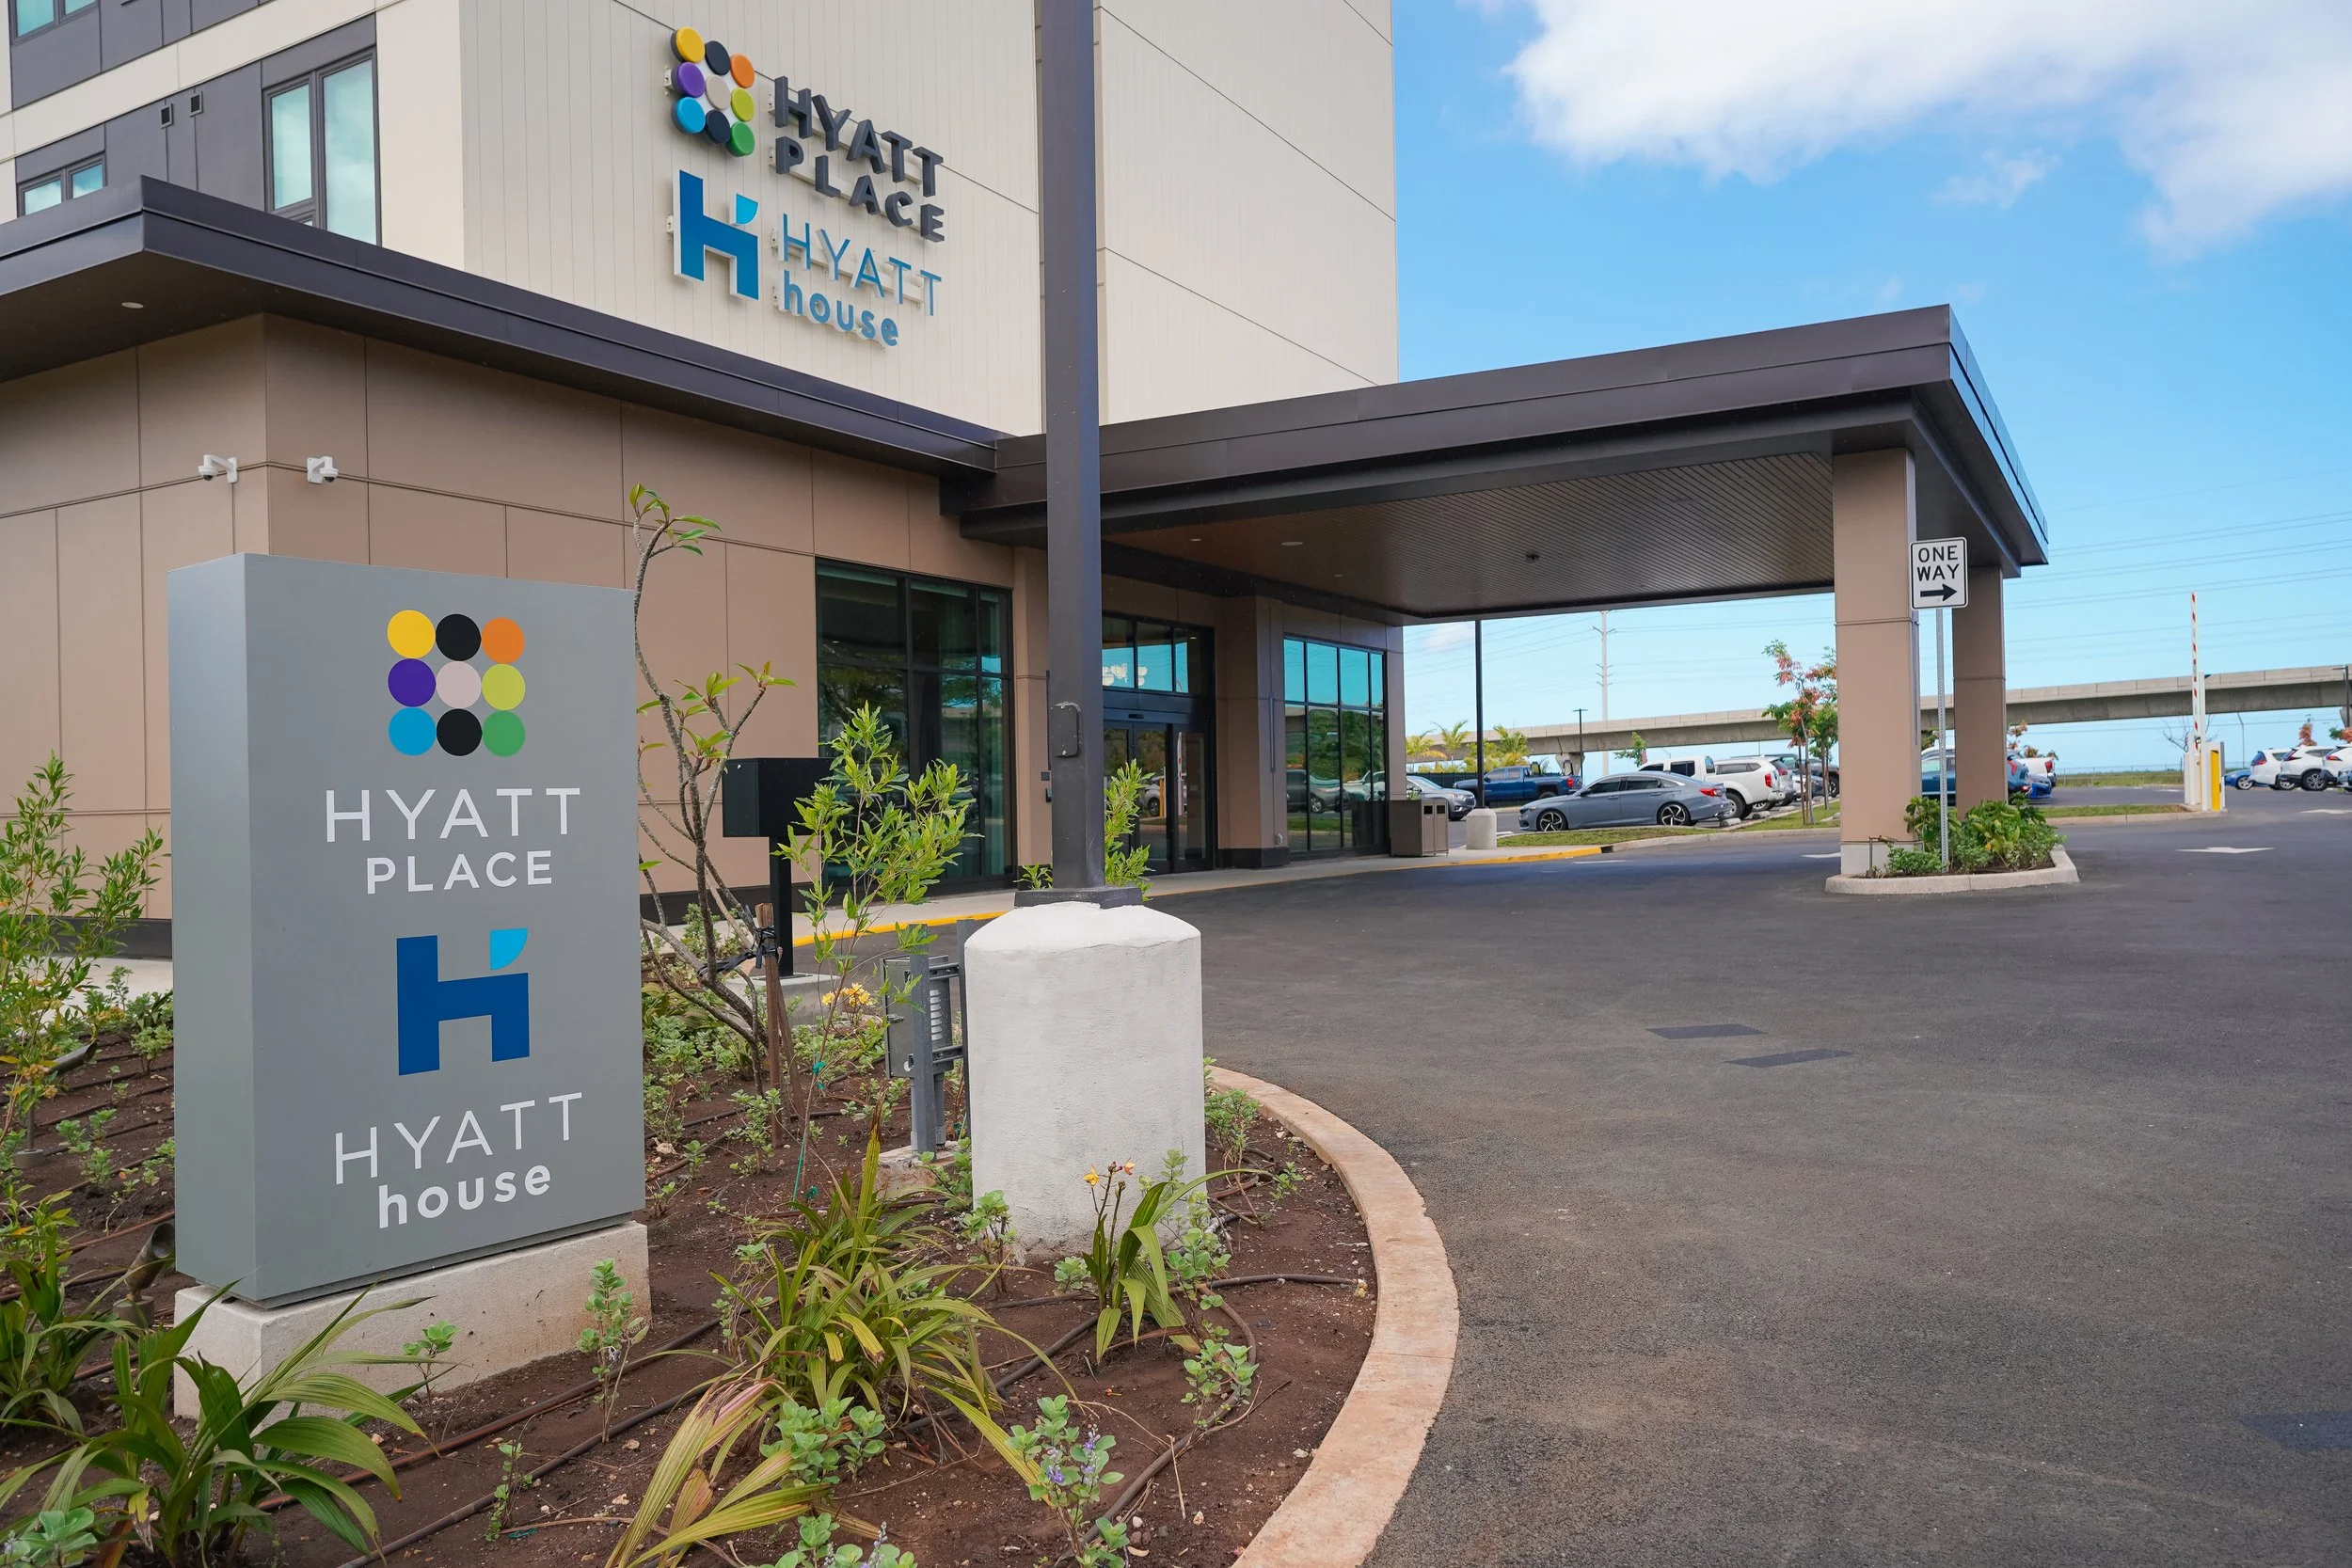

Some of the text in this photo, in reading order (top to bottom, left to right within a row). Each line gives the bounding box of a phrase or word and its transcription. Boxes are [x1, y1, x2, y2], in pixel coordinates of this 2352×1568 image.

[774, 76, 944, 198] HYATT
[775, 136, 945, 243] PLACE
[778, 213, 942, 316] HYATT
[779, 269, 899, 347] house
[1917, 563, 1960, 581] WAY
[1918, 546, 1958, 562] ONE
[326, 787, 580, 843] HYATT
[366, 849, 552, 895] PLACE
[335, 1091, 582, 1185] HYATT
[378, 1164, 551, 1228] house
